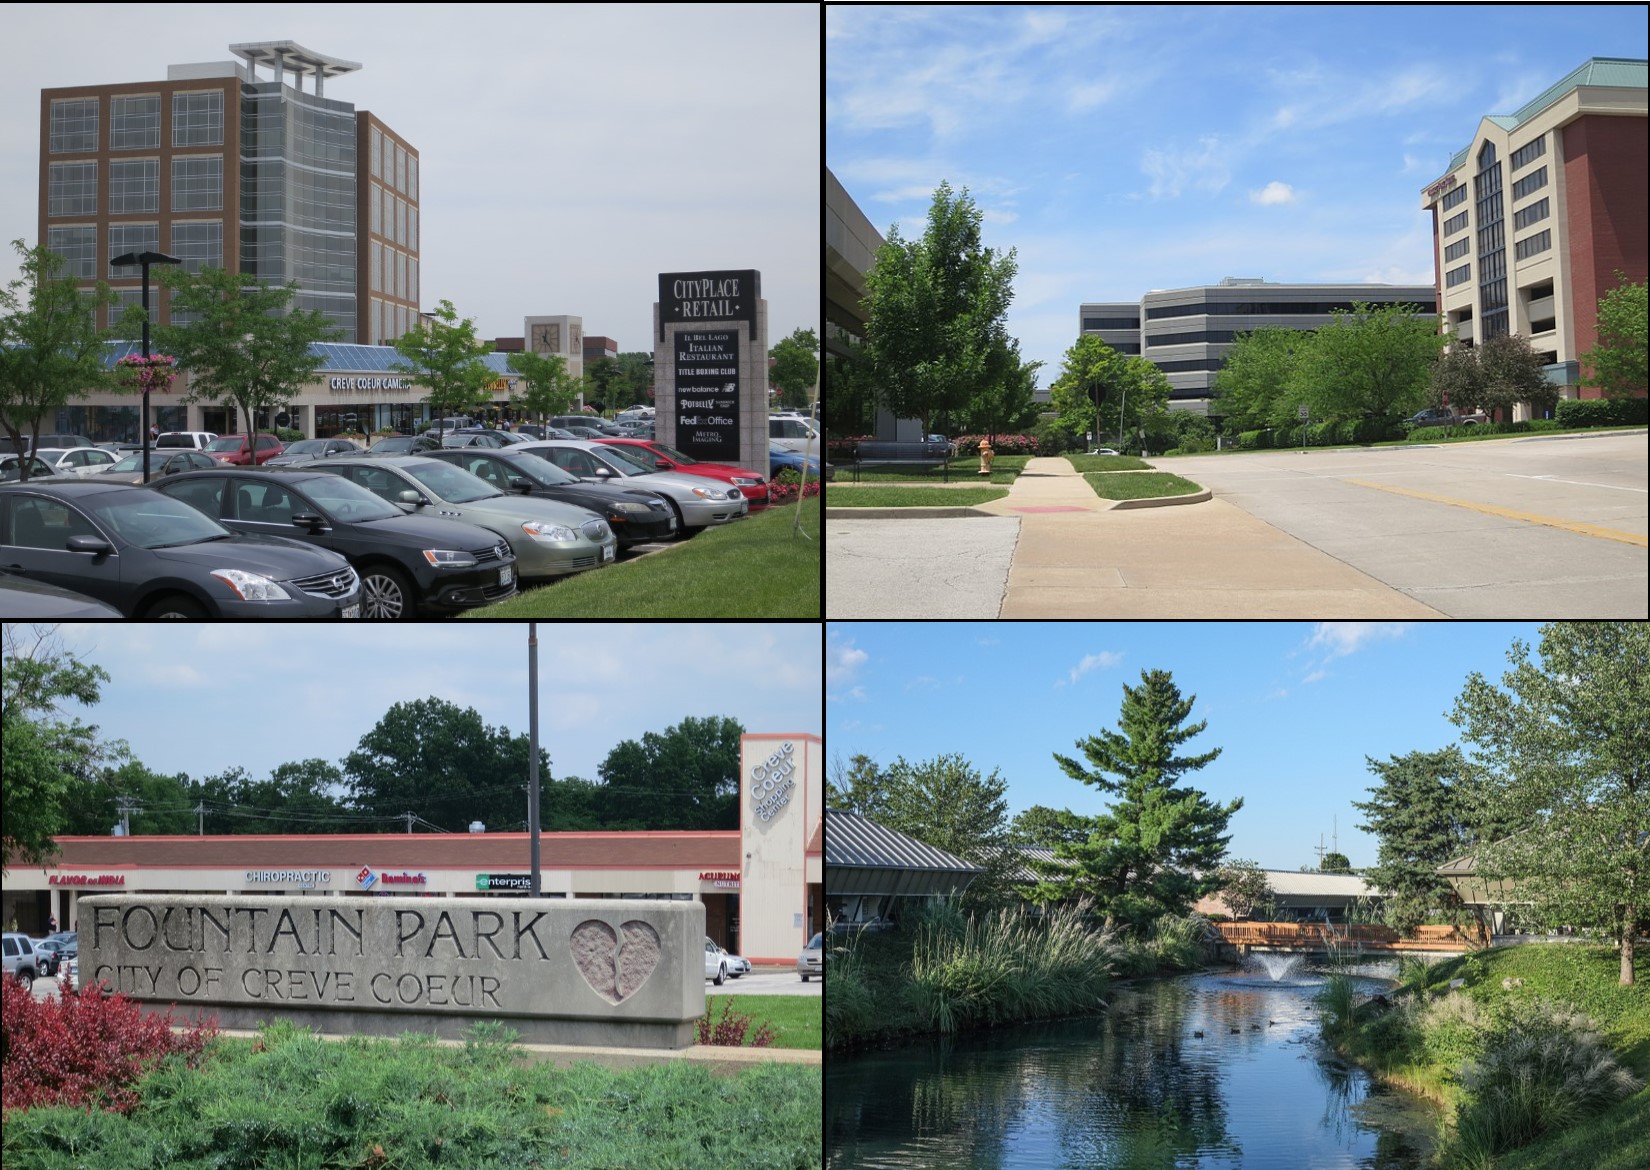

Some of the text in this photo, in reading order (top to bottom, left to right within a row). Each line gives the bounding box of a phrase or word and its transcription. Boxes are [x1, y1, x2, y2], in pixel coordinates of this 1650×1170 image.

[674, 278, 740, 299] CITYPLACE
[683, 300, 734, 317] RETAIL
[689, 342, 724, 352] ITALIAN
[679, 351, 735, 361] RESTAURANT
[678, 367, 736, 376] TITLE BOXING CLUB
[331, 377, 355, 389] CREVE
[356, 377, 381, 389] COEUR
[680, 398, 715, 409] POTBELLY
[708, 415, 733, 425] Office
[751, 740, 794, 781] Creve
[751, 757, 795, 800] Coeur
[755, 777, 797, 816] Shopping
[760, 794, 790, 822] Center
[48, 874, 87, 885] FLAVOR
[98, 874, 125, 885] INDIA
[245, 870, 331, 883] CHIROPRACTIC
[381, 872, 427, 884] Domino's
[477, 877, 531, 888] enterpris
[92, 905, 551, 961] FOUNTAIN PARK
[94, 964, 503, 1008] CITY OF CREVE COEUR
